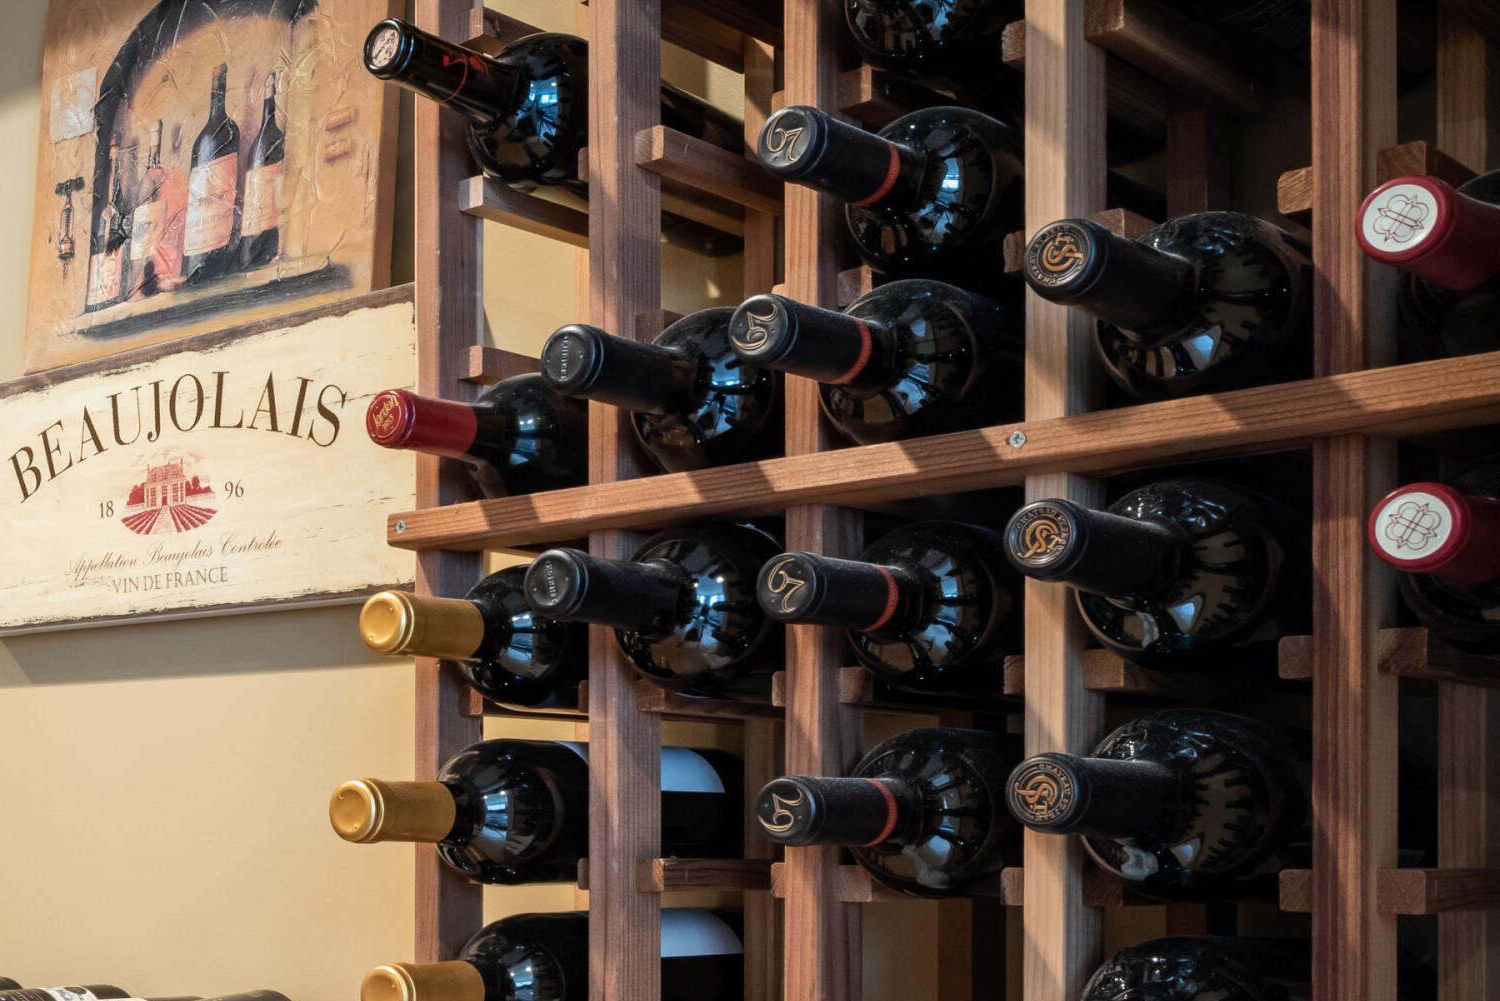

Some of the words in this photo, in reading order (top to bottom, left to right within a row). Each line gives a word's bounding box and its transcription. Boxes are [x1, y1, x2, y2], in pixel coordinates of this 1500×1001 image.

[7, 370, 348, 504] BEAUJOLAIS
[224, 480, 245, 499] 96
[100, 500, 115, 519] 18
[64, 551, 138, 583] Appellation
[144, 539, 214, 567] Beaujolais
[112, 576, 140, 593] VIN
[143, 573, 162, 592] DE
[165, 566, 229, 589] FRANCE
